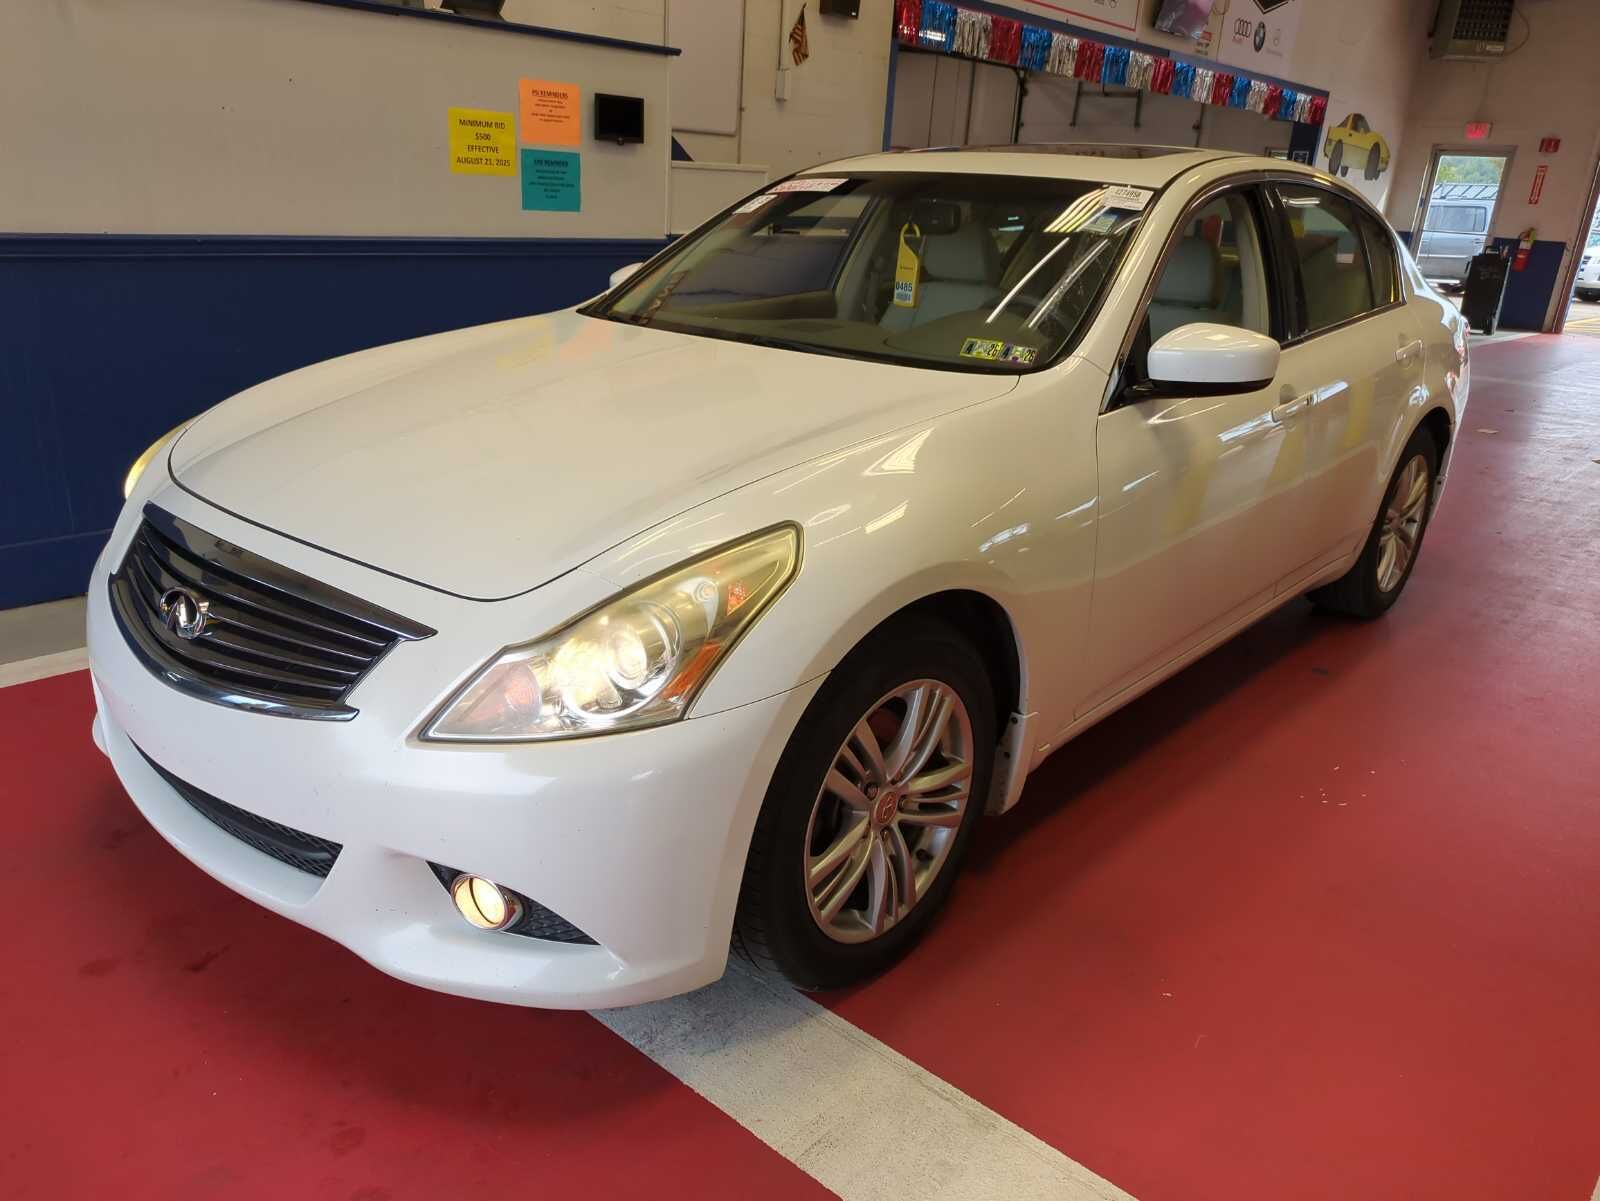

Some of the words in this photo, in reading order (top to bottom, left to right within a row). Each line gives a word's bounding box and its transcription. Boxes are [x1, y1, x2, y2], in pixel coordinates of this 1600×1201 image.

[458, 119, 493, 128] MINIMUM
[495, 121, 506, 130] BID
[475, 132, 491, 141] $500
[467, 144, 499, 154] EFFECTIVE
[456, 156, 483, 165] AUGUST
[495, 159, 512, 167] 2025
